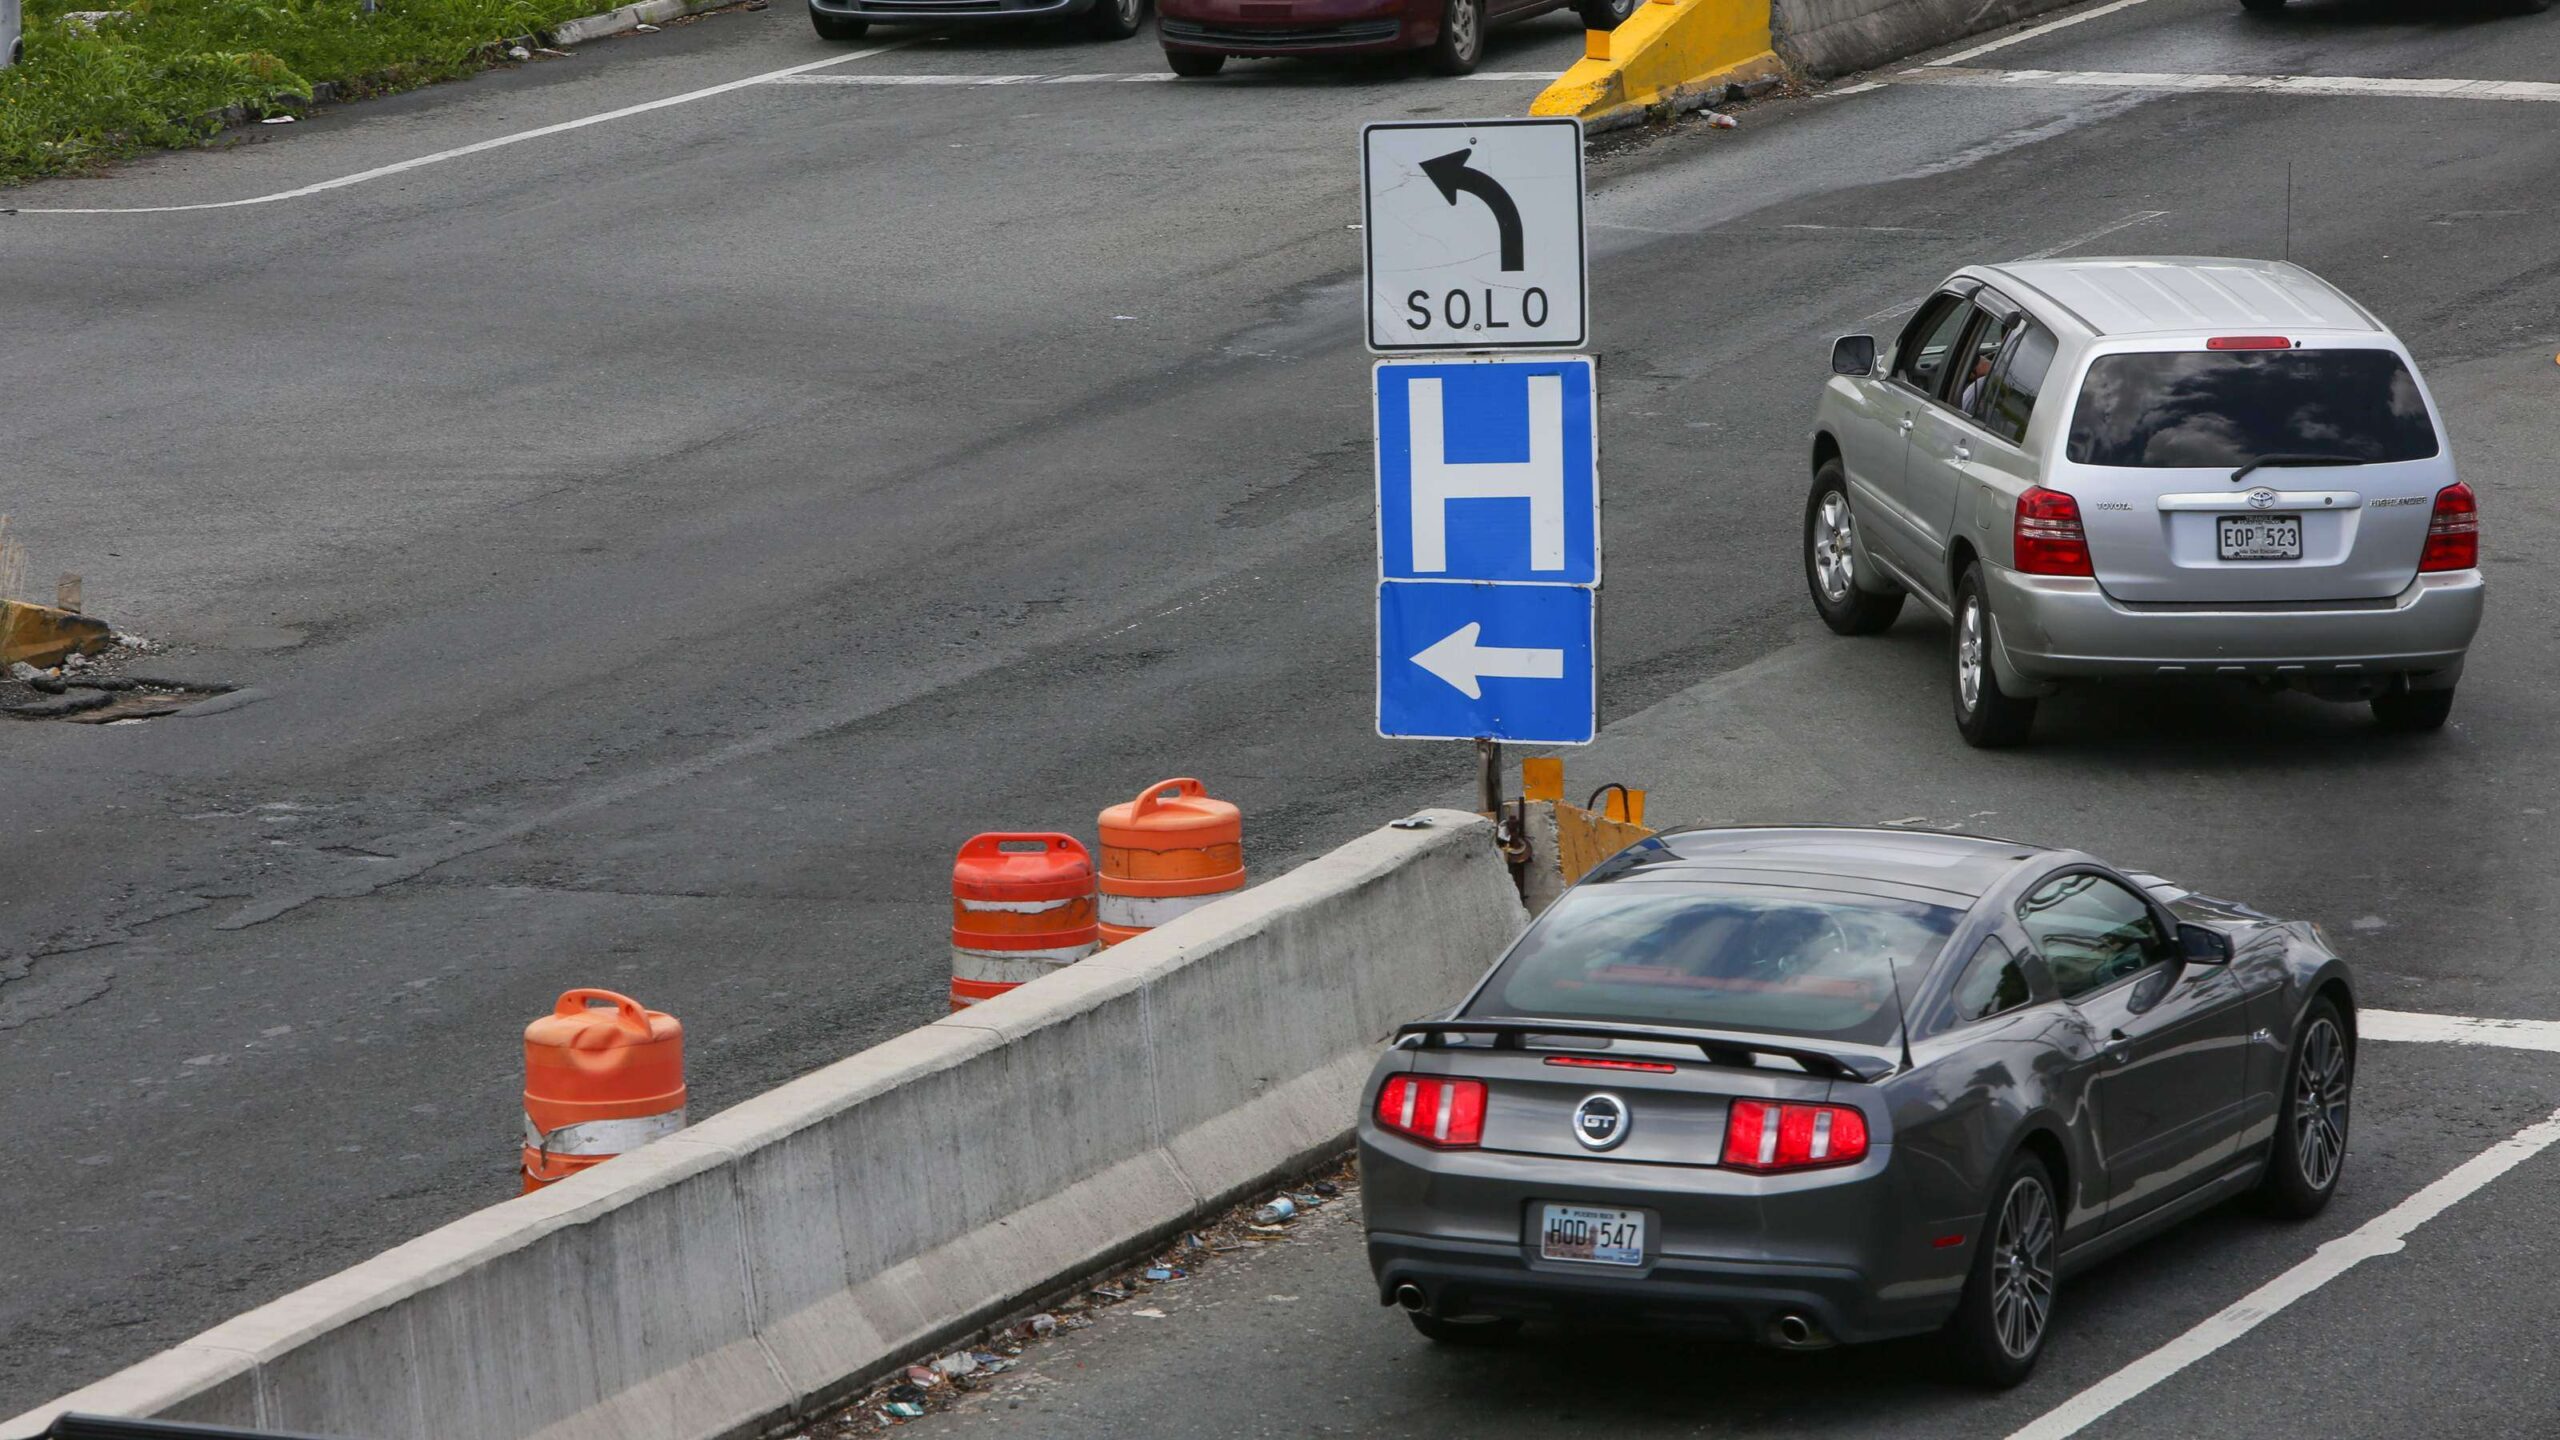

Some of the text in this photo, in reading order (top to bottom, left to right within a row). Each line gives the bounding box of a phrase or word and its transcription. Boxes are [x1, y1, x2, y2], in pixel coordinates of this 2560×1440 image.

[1406, 287, 1548, 330] SOLO
[1408, 375, 1565, 572] H
[2096, 501, 2133, 511] TOYOTA
[2369, 496, 2427, 507] HIGHLANDER
[2224, 528, 2297, 547] EOP 523
[1584, 1114, 1615, 1128] GT
[1551, 1218, 1637, 1250] HOD 547
